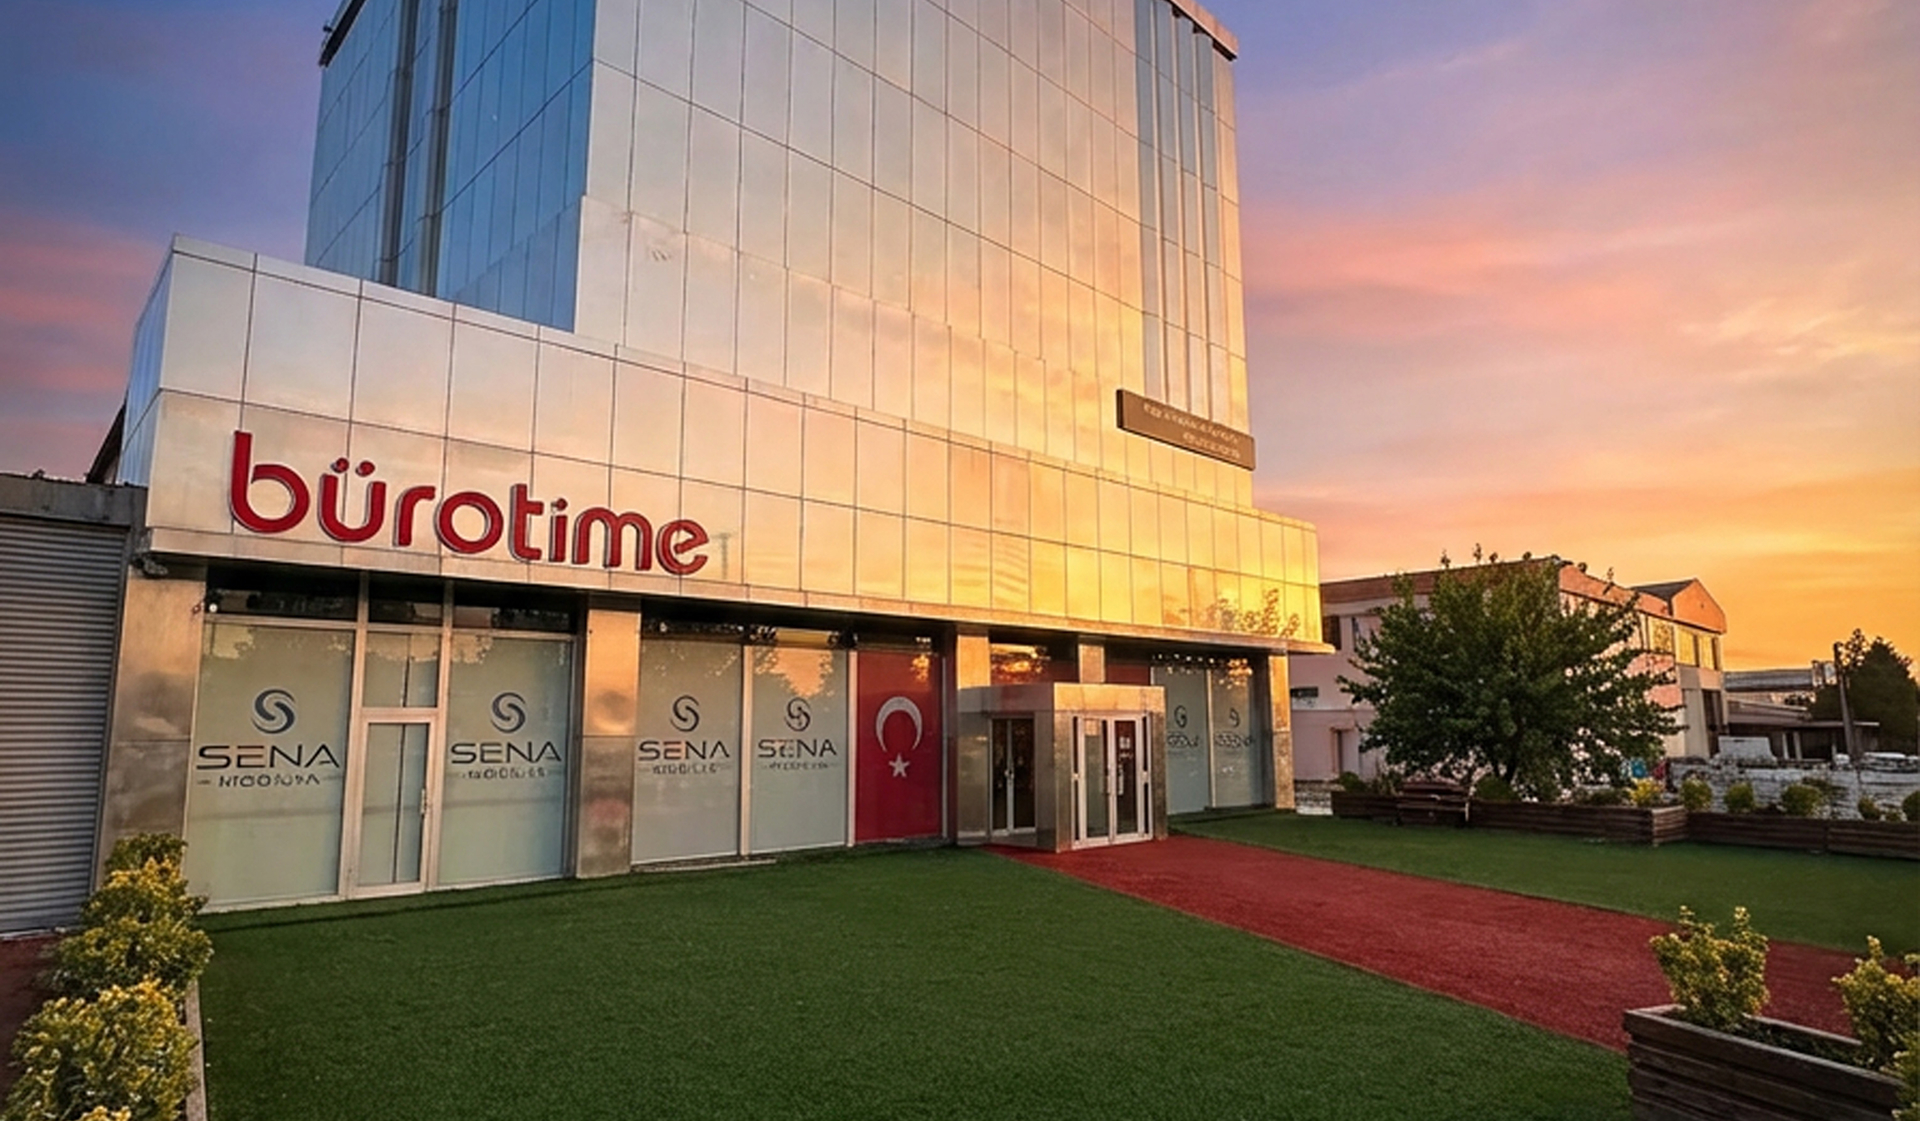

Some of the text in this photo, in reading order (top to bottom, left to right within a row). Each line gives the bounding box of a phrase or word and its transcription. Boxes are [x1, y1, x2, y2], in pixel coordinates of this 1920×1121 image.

[230, 430, 710, 576] bürotime
[196, 743, 340, 770] SENA
[450, 740, 562, 764] SENA
[638, 740, 730, 761] SENA
